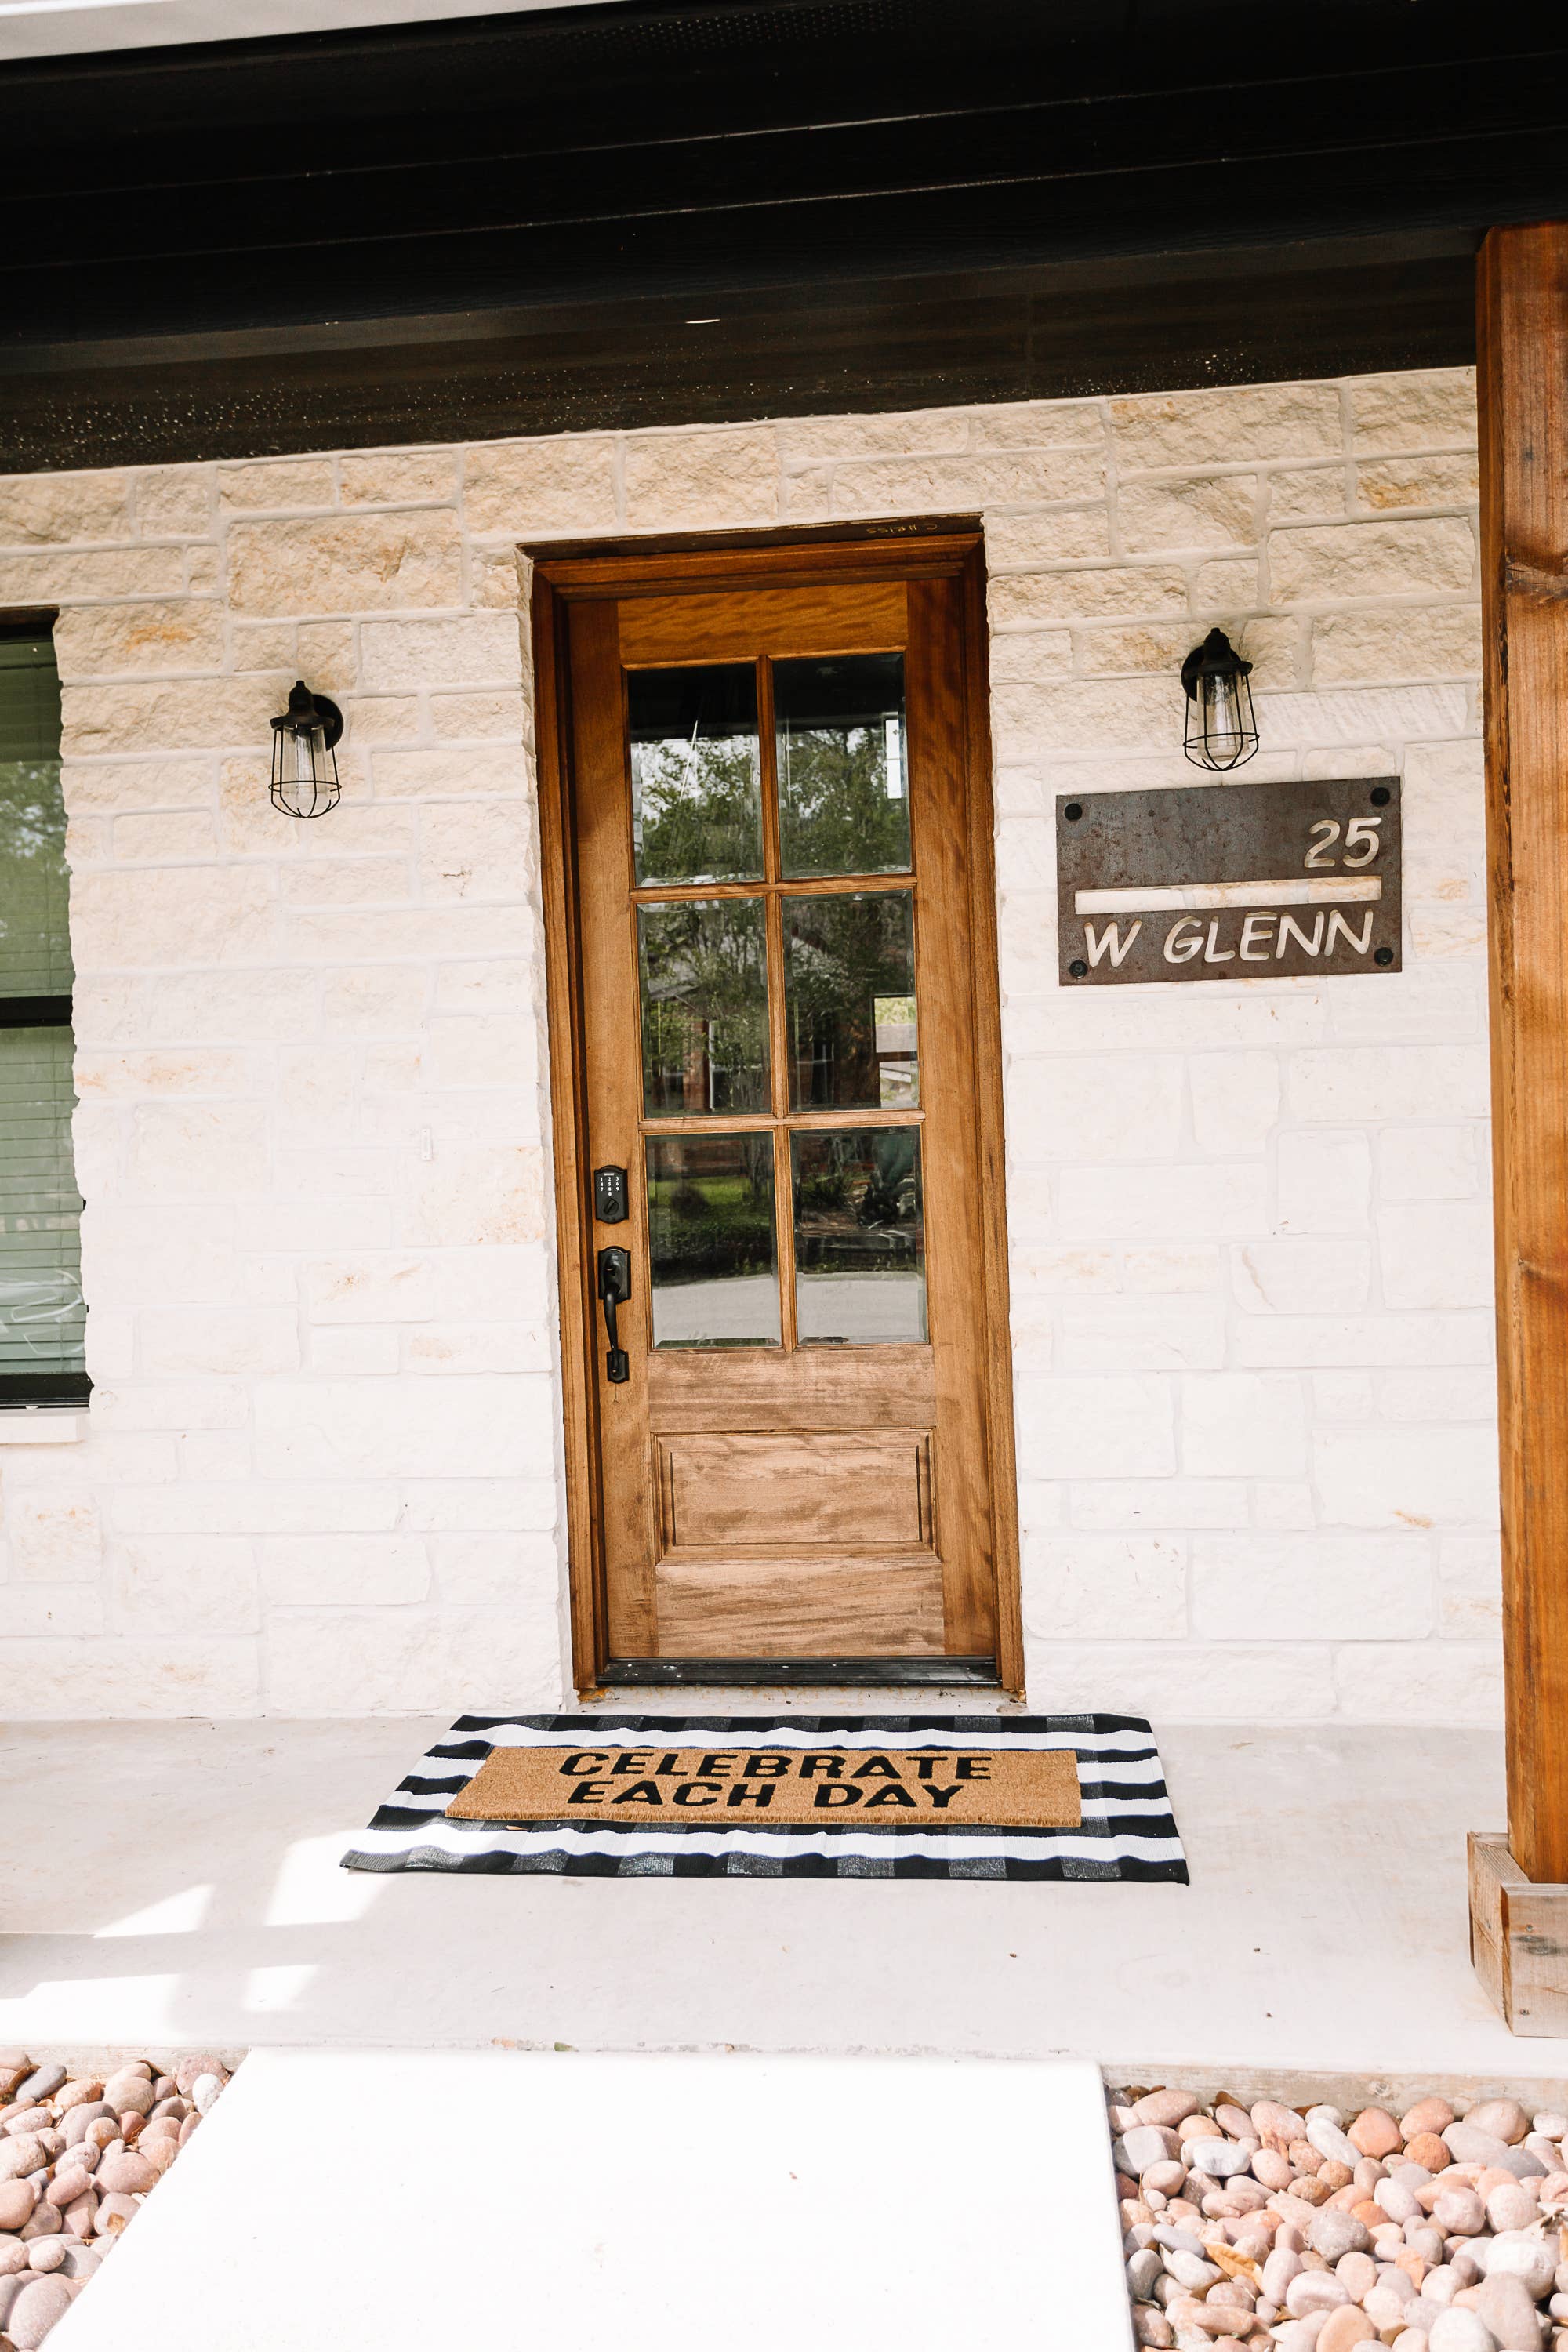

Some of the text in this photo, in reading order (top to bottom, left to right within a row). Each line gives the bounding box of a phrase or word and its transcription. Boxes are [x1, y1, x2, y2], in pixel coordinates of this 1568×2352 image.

[1304, 816, 1382, 869] 25
[1083, 909, 1374, 967] W GLENN
[558, 1752, 993, 1780] CELEBRATE
[567, 1780, 964, 1809] EACH DAY
